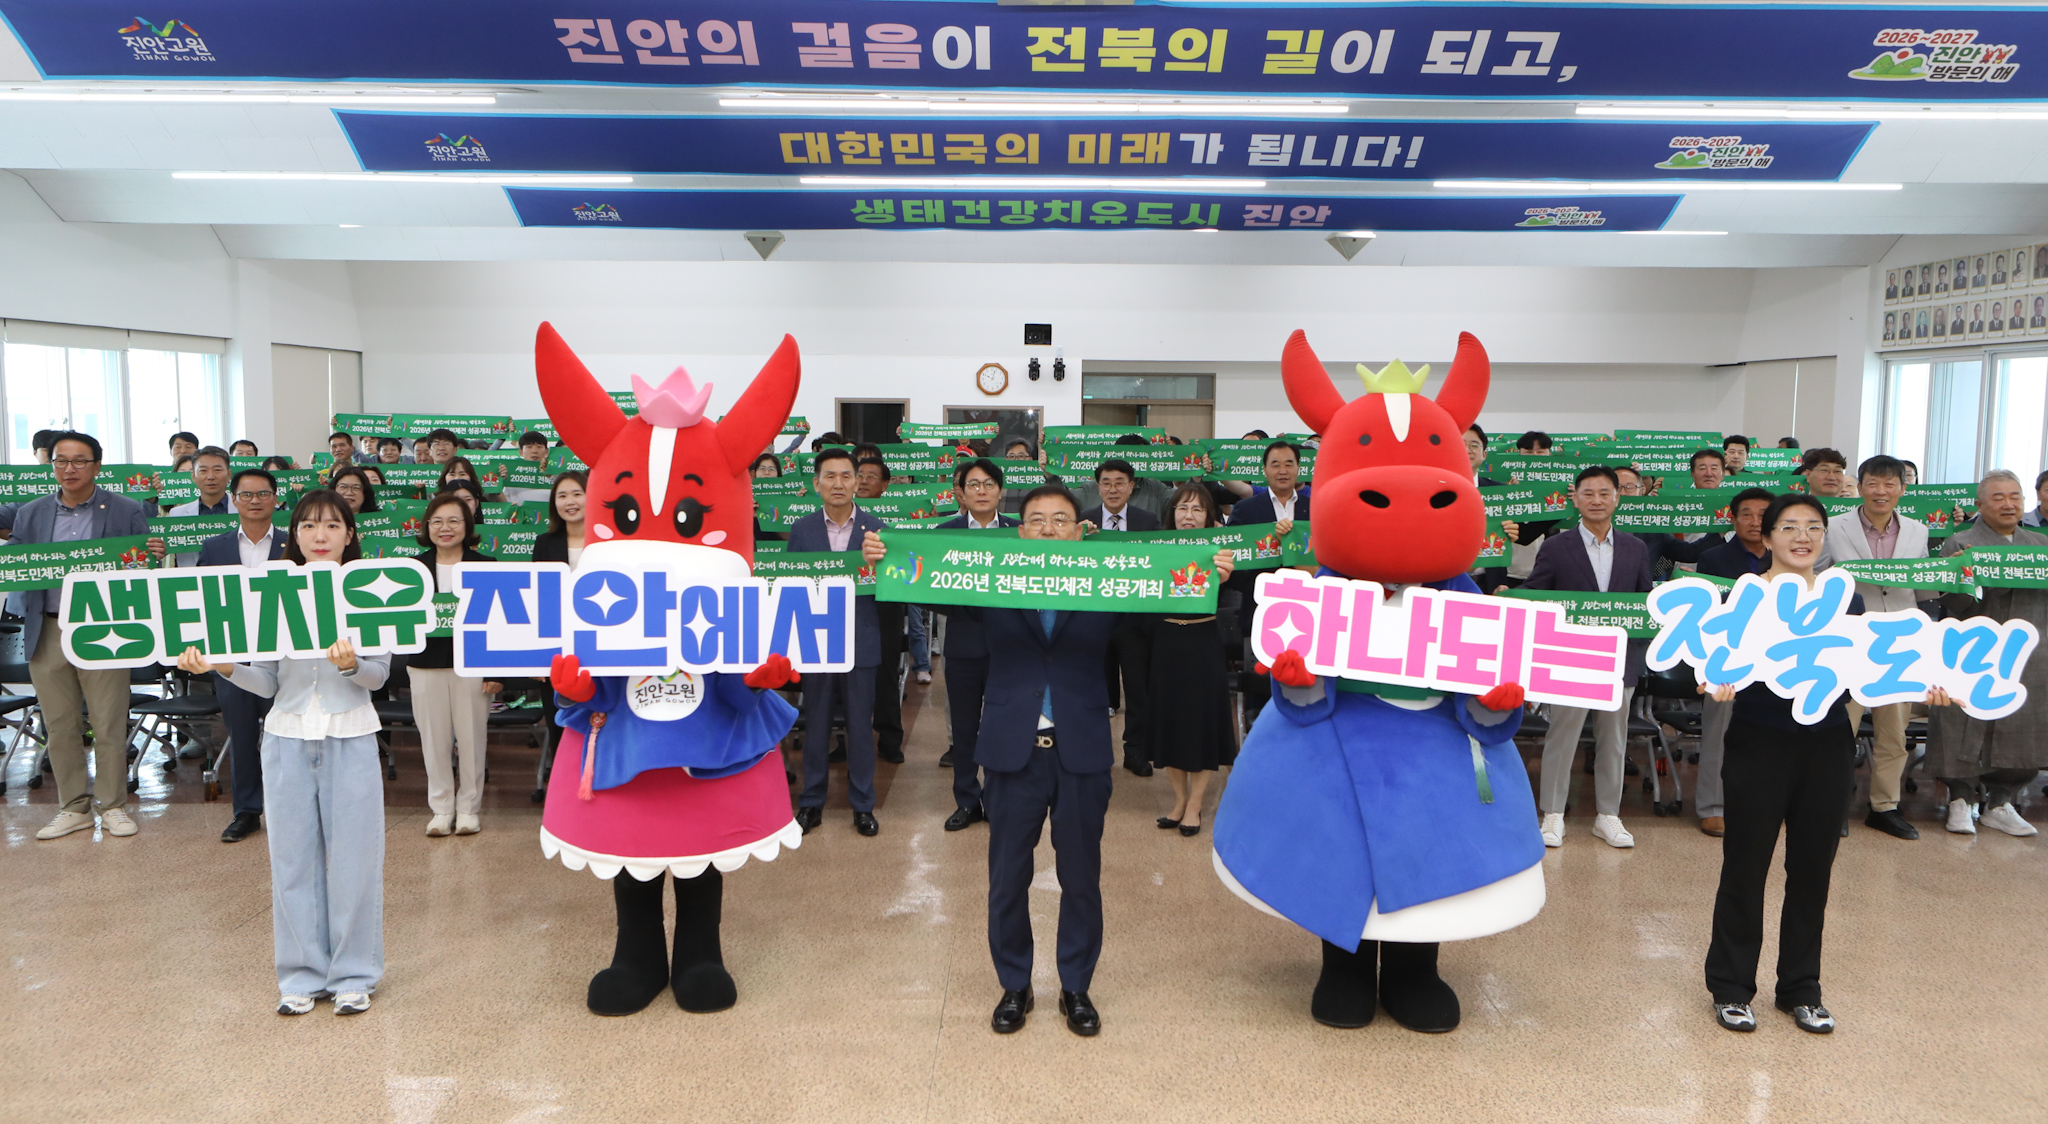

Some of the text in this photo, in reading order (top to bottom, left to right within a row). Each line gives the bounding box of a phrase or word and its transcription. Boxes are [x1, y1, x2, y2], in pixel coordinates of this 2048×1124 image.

[1877, 32, 1975, 45] 2026~2027
[121, 36, 212, 56] 진안고원
[553, 18, 1580, 84] 진안의 걸음이 전북의 길이 되고,
[1931, 46, 1982, 64] 진안
[1929, 65, 2015, 81] 방문의 해
[1671, 138, 1739, 147] 2026~2027
[426, 145, 489, 159] 진안고원
[778, 131, 1425, 169] 대한민국의 미래가 됩니다!
[1712, 146, 1745, 158] 진안
[1711, 158, 1770, 168] 방문의 해
[850, 199, 1332, 228] 생태건강치유도시 진안
[566, 462, 589, 471] 2026
[908, 461, 936, 470] 성공개최
[1070, 461, 1099, 471] 2026년
[1148, 461, 1181, 472] 성공개최
[1230, 465, 1260, 476] 2026년
[1766, 460, 1789, 468] 성공개최
[510, 474, 536, 484] 2026년
[1526, 471, 1575, 483] 전북도민체전
[1504, 503, 1542, 515] 성공개최
[1614, 514, 1711, 527] 전북도민체전 성공개최
[502, 543, 535, 555] 2026년
[942, 549, 1153, 571] 생태치유 진안에서 하나되는 전북도민
[1910, 570, 1957, 586] 성공개최
[930, 571, 1164, 600] 2026년 전북도민체전 성공개최
[68, 566, 428, 662] 생태치유
[461, 570, 847, 668] 진안에서
[1260, 577, 1618, 703] 하나되는
[1655, 577, 2030, 716] 전북도민
[635, 682, 697, 704] 진안고원
[634, 697, 697, 711] JINAN GOWON
